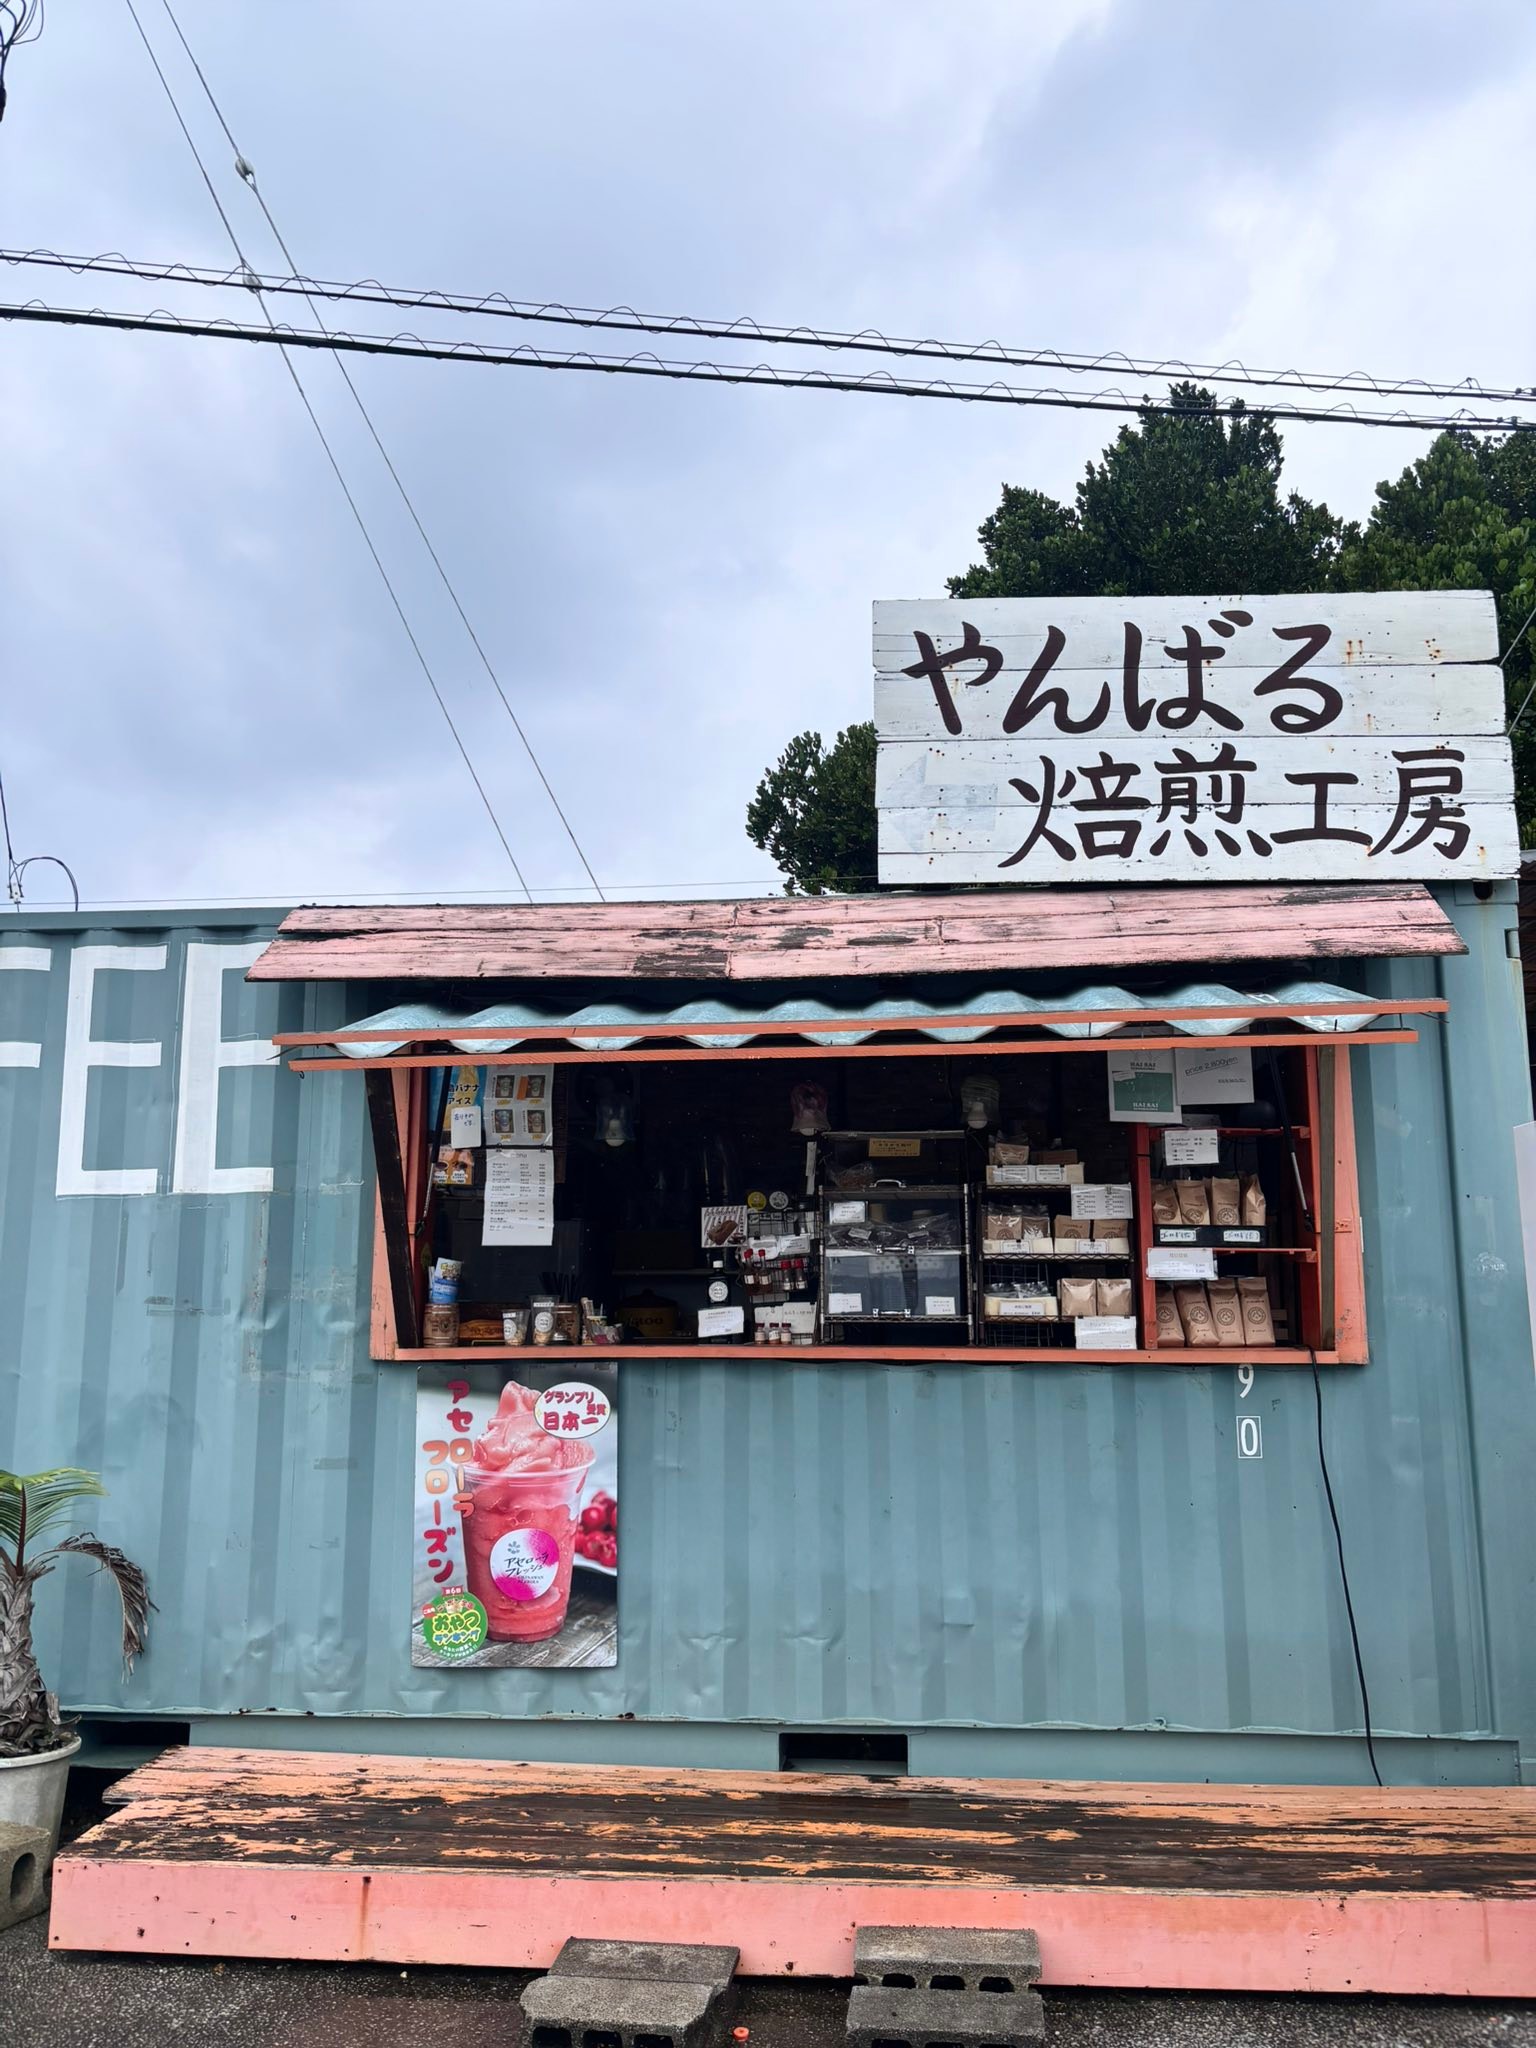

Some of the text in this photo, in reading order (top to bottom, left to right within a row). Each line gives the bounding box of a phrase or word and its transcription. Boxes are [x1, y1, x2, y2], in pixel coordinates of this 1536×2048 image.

[901, 611, 1343, 735] やんばる
[998, 743, 1471, 868] 焙煎工房
[544, 1390, 594, 1404] グランプリ
[1238, 1364, 1255, 1398] 9
[543, 1411, 599, 1431] 日本一
[1240, 1418, 1259, 1456] 0
[447, 1380, 474, 1519] アセローラ
[422, 1440, 456, 1583] フローズン
[433, 1610, 480, 1632] おやつ
